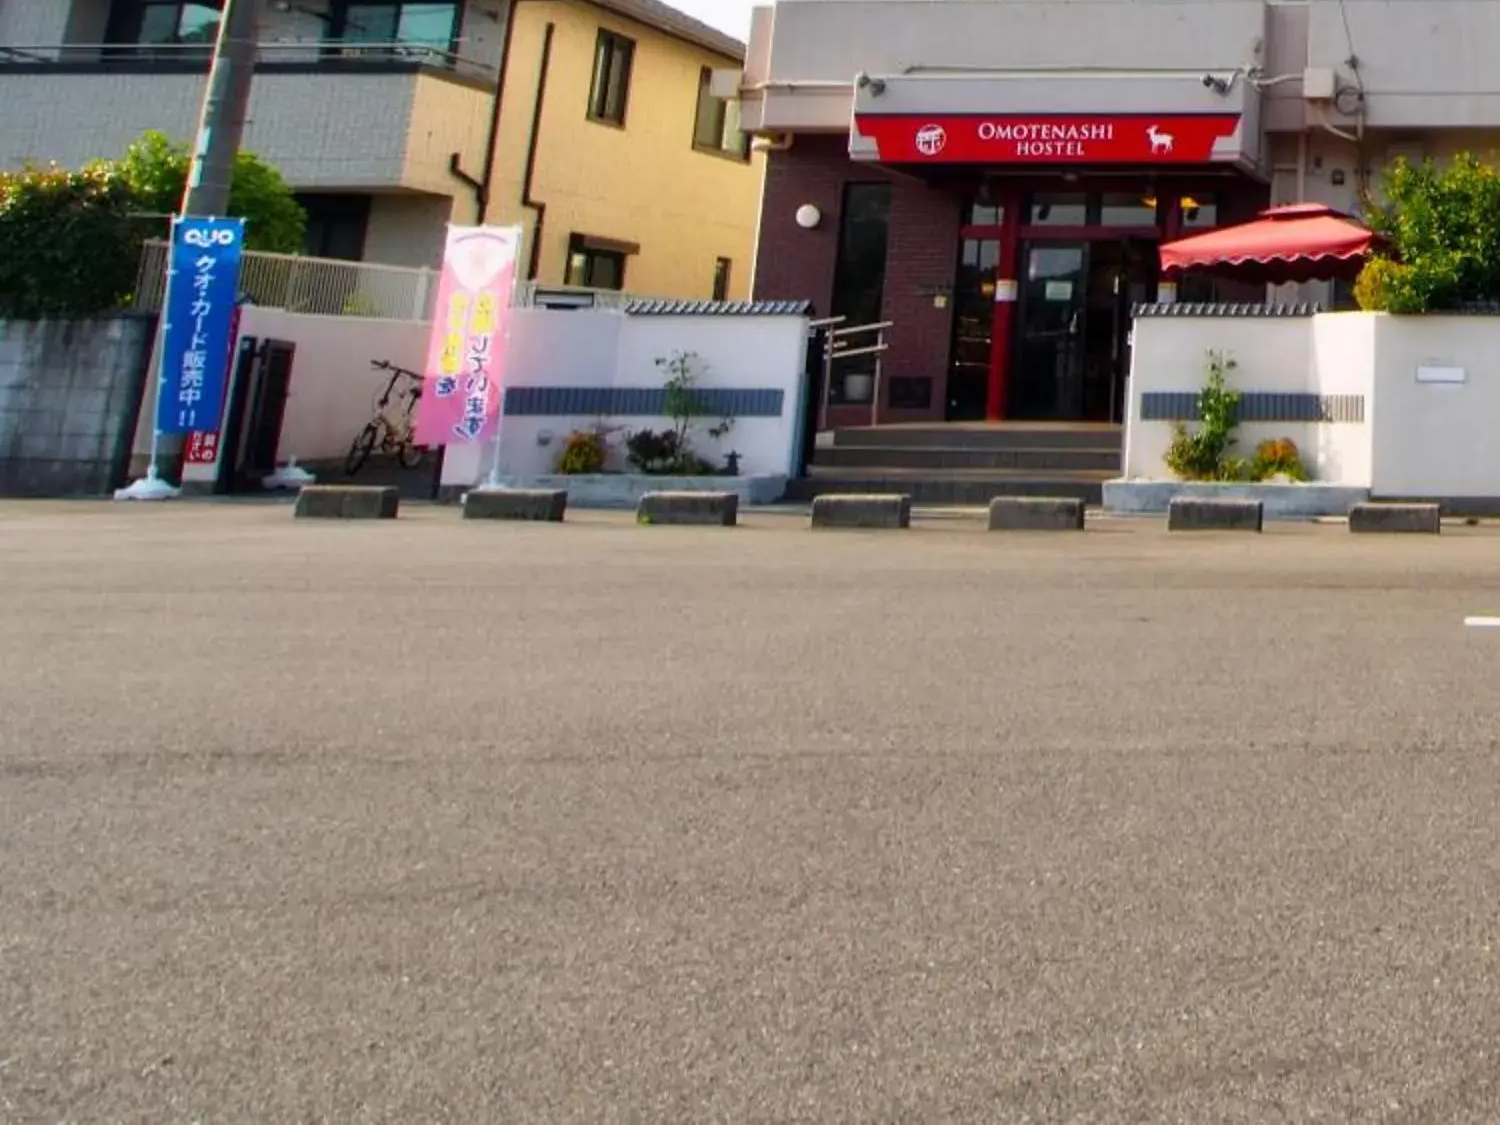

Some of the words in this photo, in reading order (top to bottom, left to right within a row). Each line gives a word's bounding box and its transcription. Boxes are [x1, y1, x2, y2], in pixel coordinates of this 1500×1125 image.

[978, 122, 1113, 140] OMOTENASHI
[1016, 141, 1085, 156] HOSTEL
[184, 229, 234, 247] QUO
